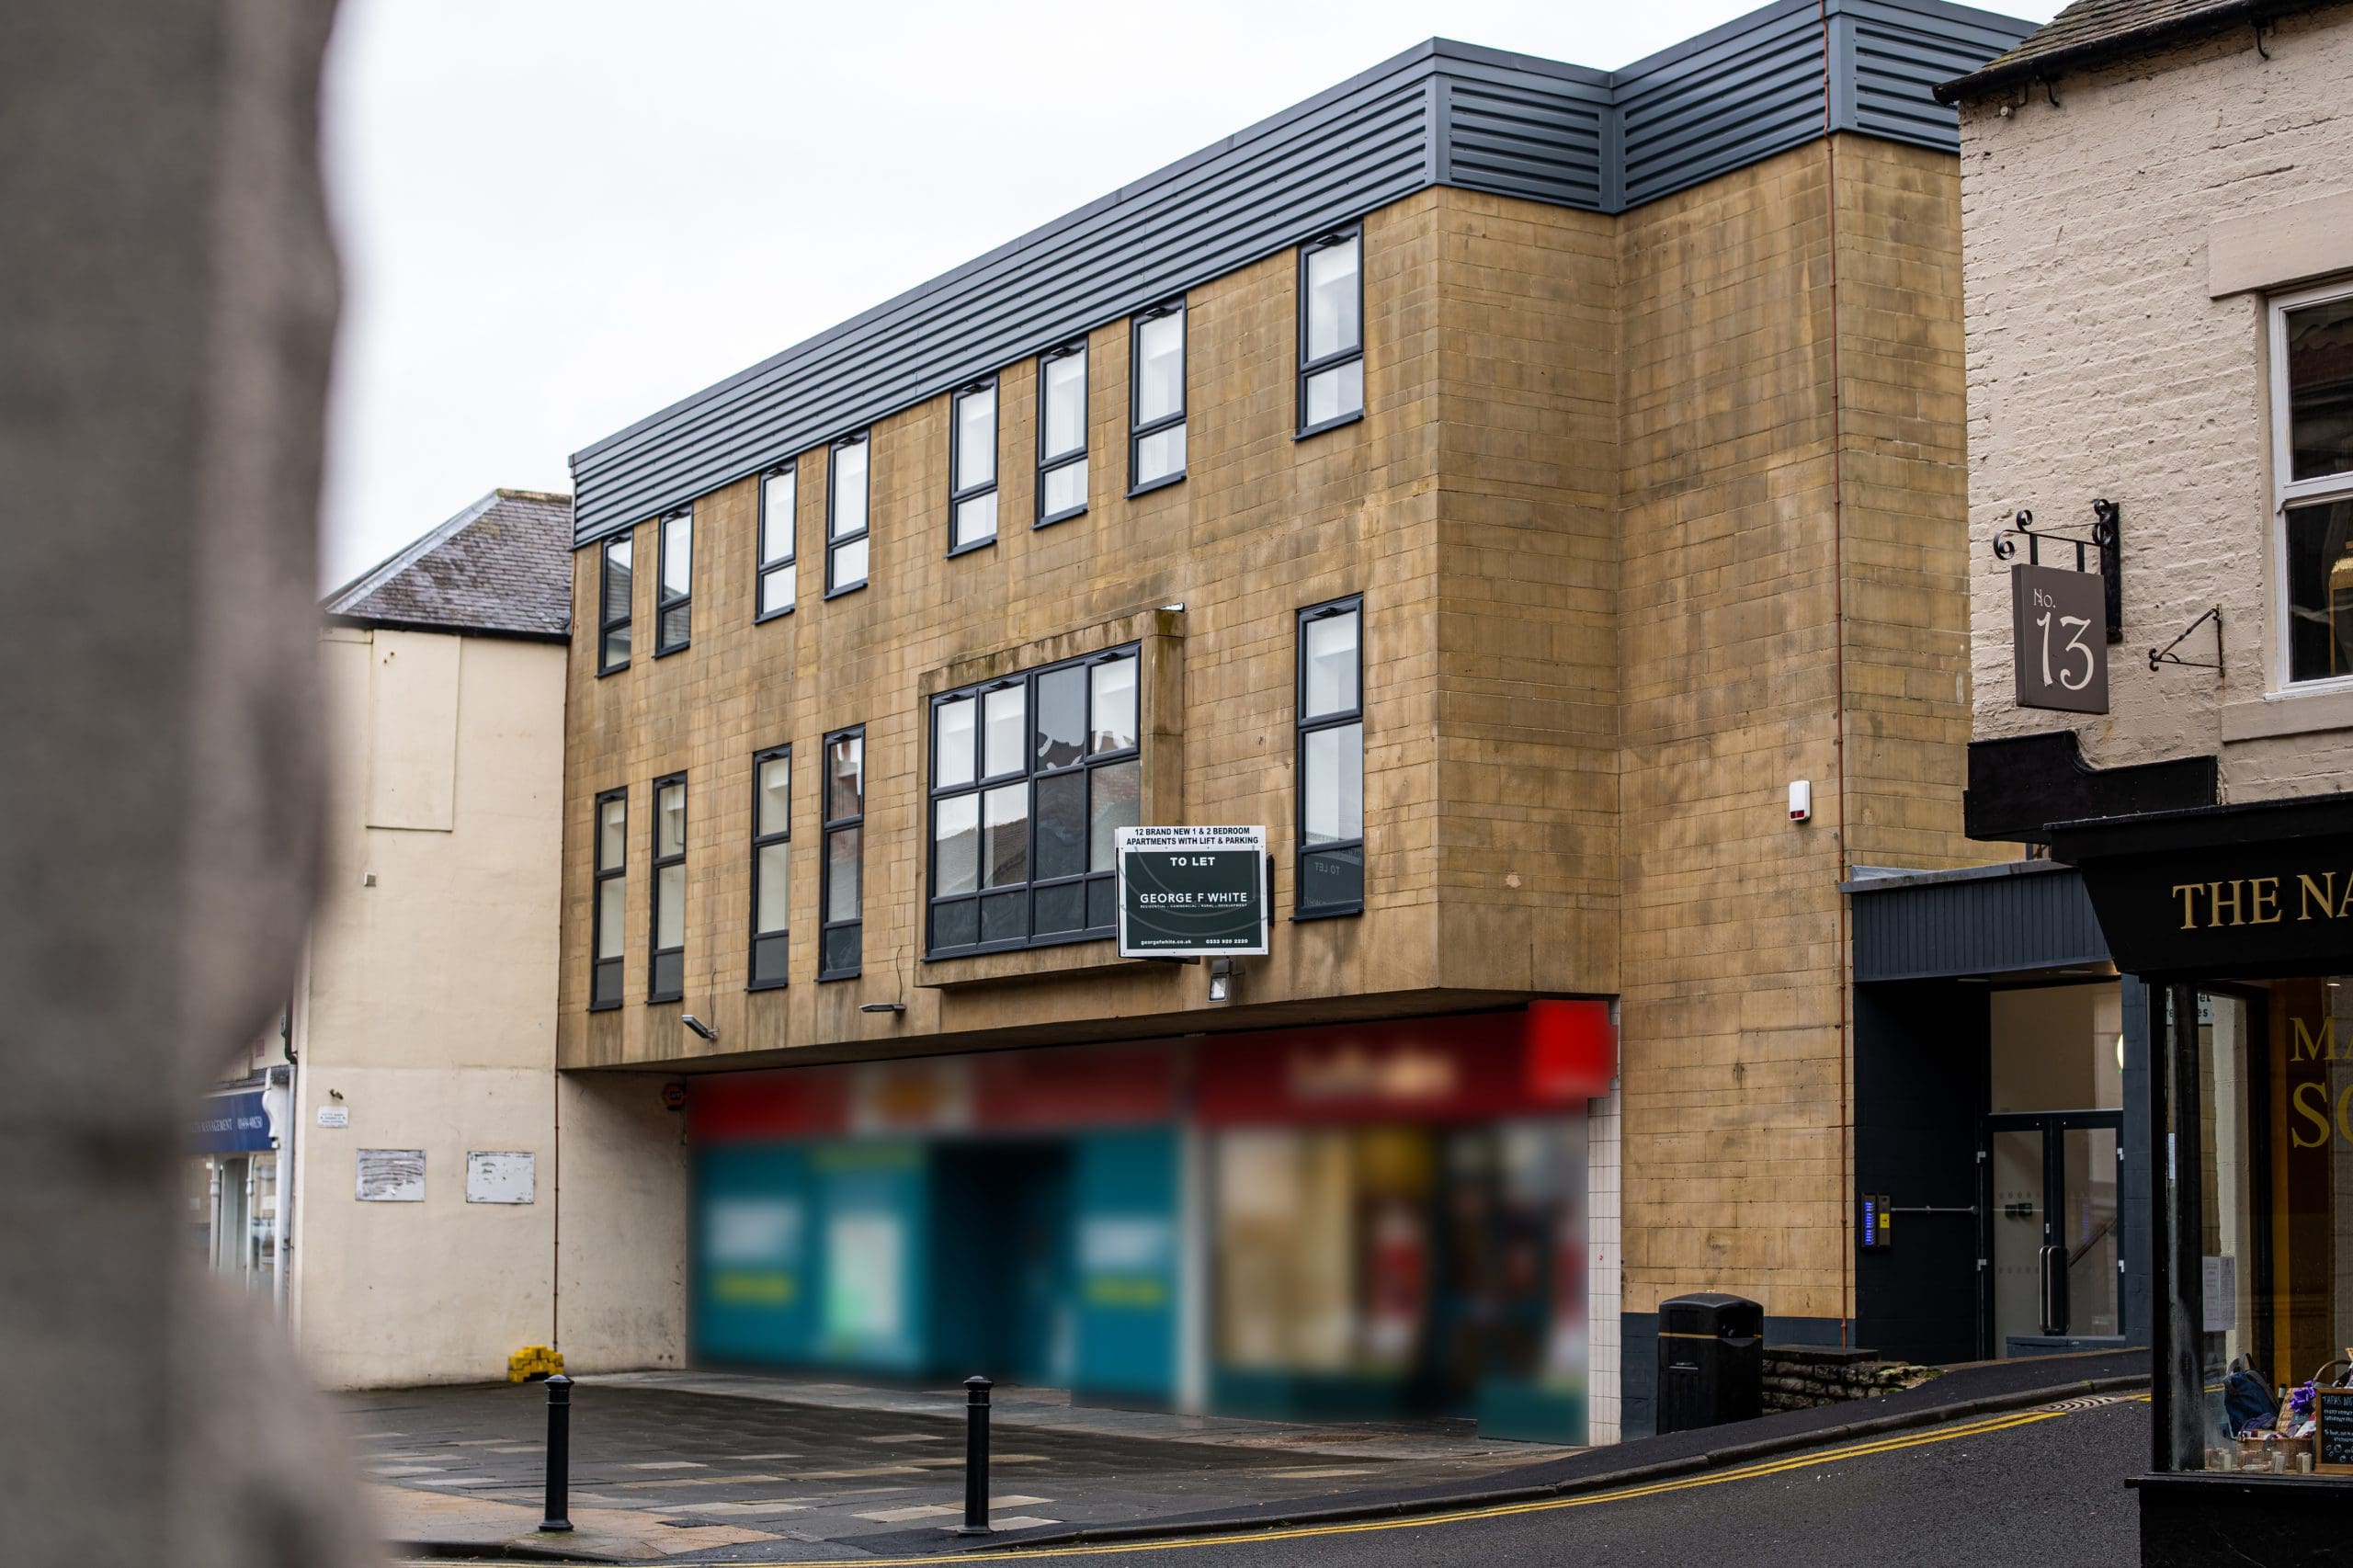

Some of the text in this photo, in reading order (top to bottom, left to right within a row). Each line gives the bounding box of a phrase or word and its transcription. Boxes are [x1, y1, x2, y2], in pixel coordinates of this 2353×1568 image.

[2033, 588, 2056, 608] No.
[2036, 611, 2094, 690] 13
[1173, 827, 1190, 835] NEW
[1170, 857, 1215, 867] TO LET
[1140, 892, 1247, 903] GEORGE F WHITE
[2172, 876, 2282, 930] THE
[2289, 1016, 2353, 1062] M
